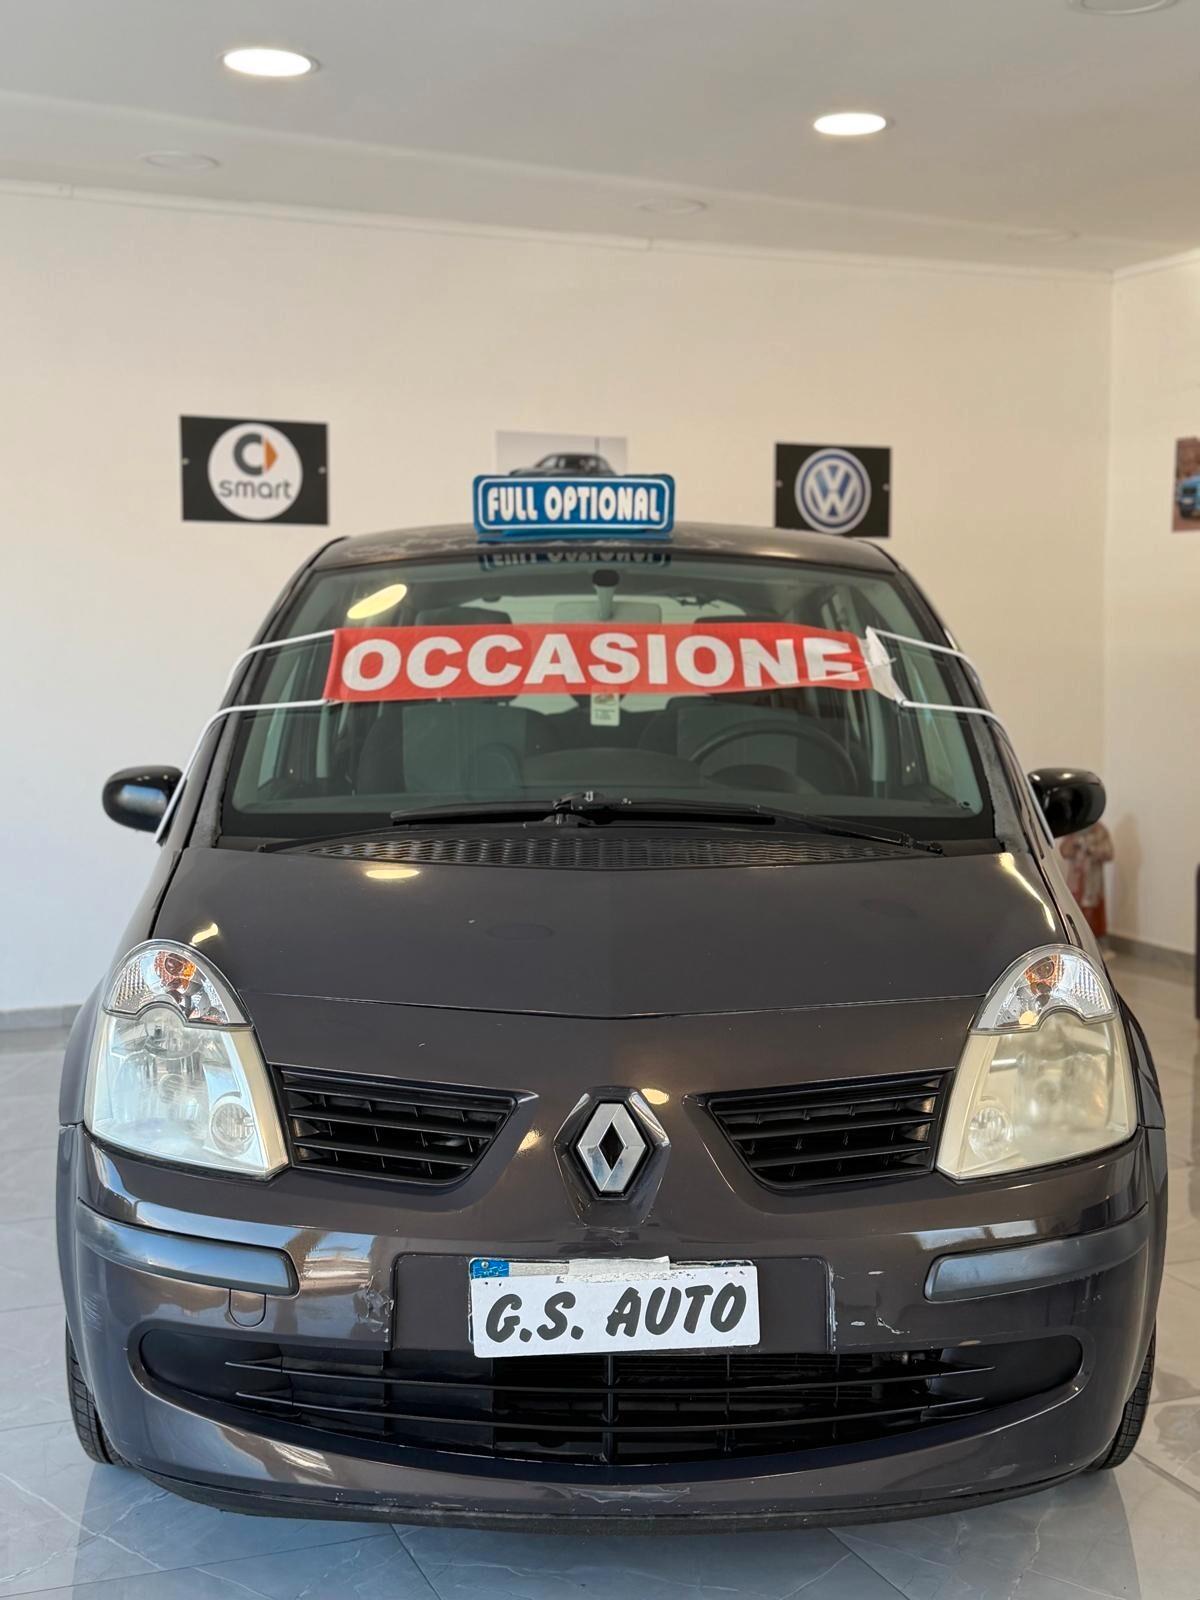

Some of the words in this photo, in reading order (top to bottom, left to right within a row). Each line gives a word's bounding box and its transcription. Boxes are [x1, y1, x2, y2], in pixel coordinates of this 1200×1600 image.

[219, 480, 292, 499] smart
[487, 486, 538, 521] FULL
[544, 486, 660, 521] OPTIONAL
[341, 633, 860, 691] OCCASIONE
[485, 1291, 584, 1343] G.S.
[605, 1283, 747, 1337] AUTO
